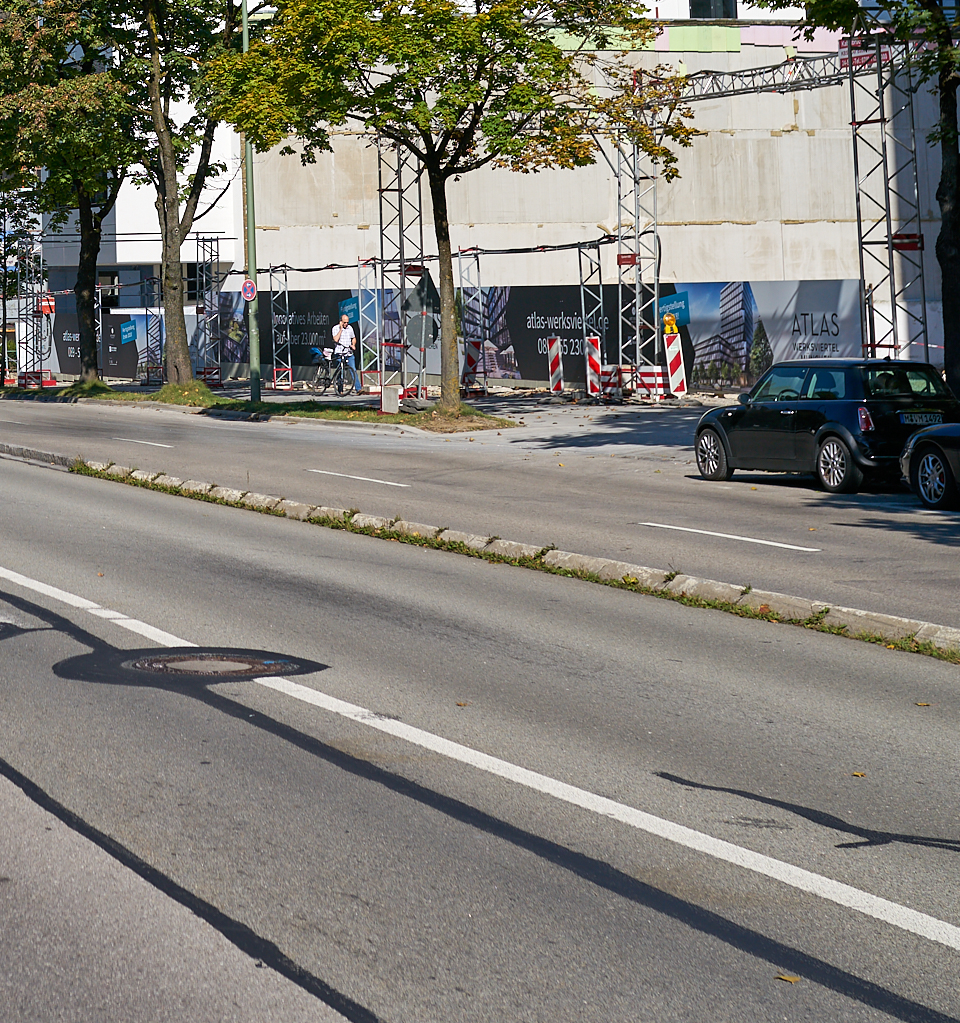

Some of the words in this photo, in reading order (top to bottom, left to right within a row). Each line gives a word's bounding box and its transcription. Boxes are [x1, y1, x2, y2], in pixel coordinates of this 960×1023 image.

[307, 311, 330, 325] Arbeiten
[792, 313, 840, 336] ATLAS
[287, 331, 300, 345] ber
[792, 342, 840, 352] WERKSVIERTEL
